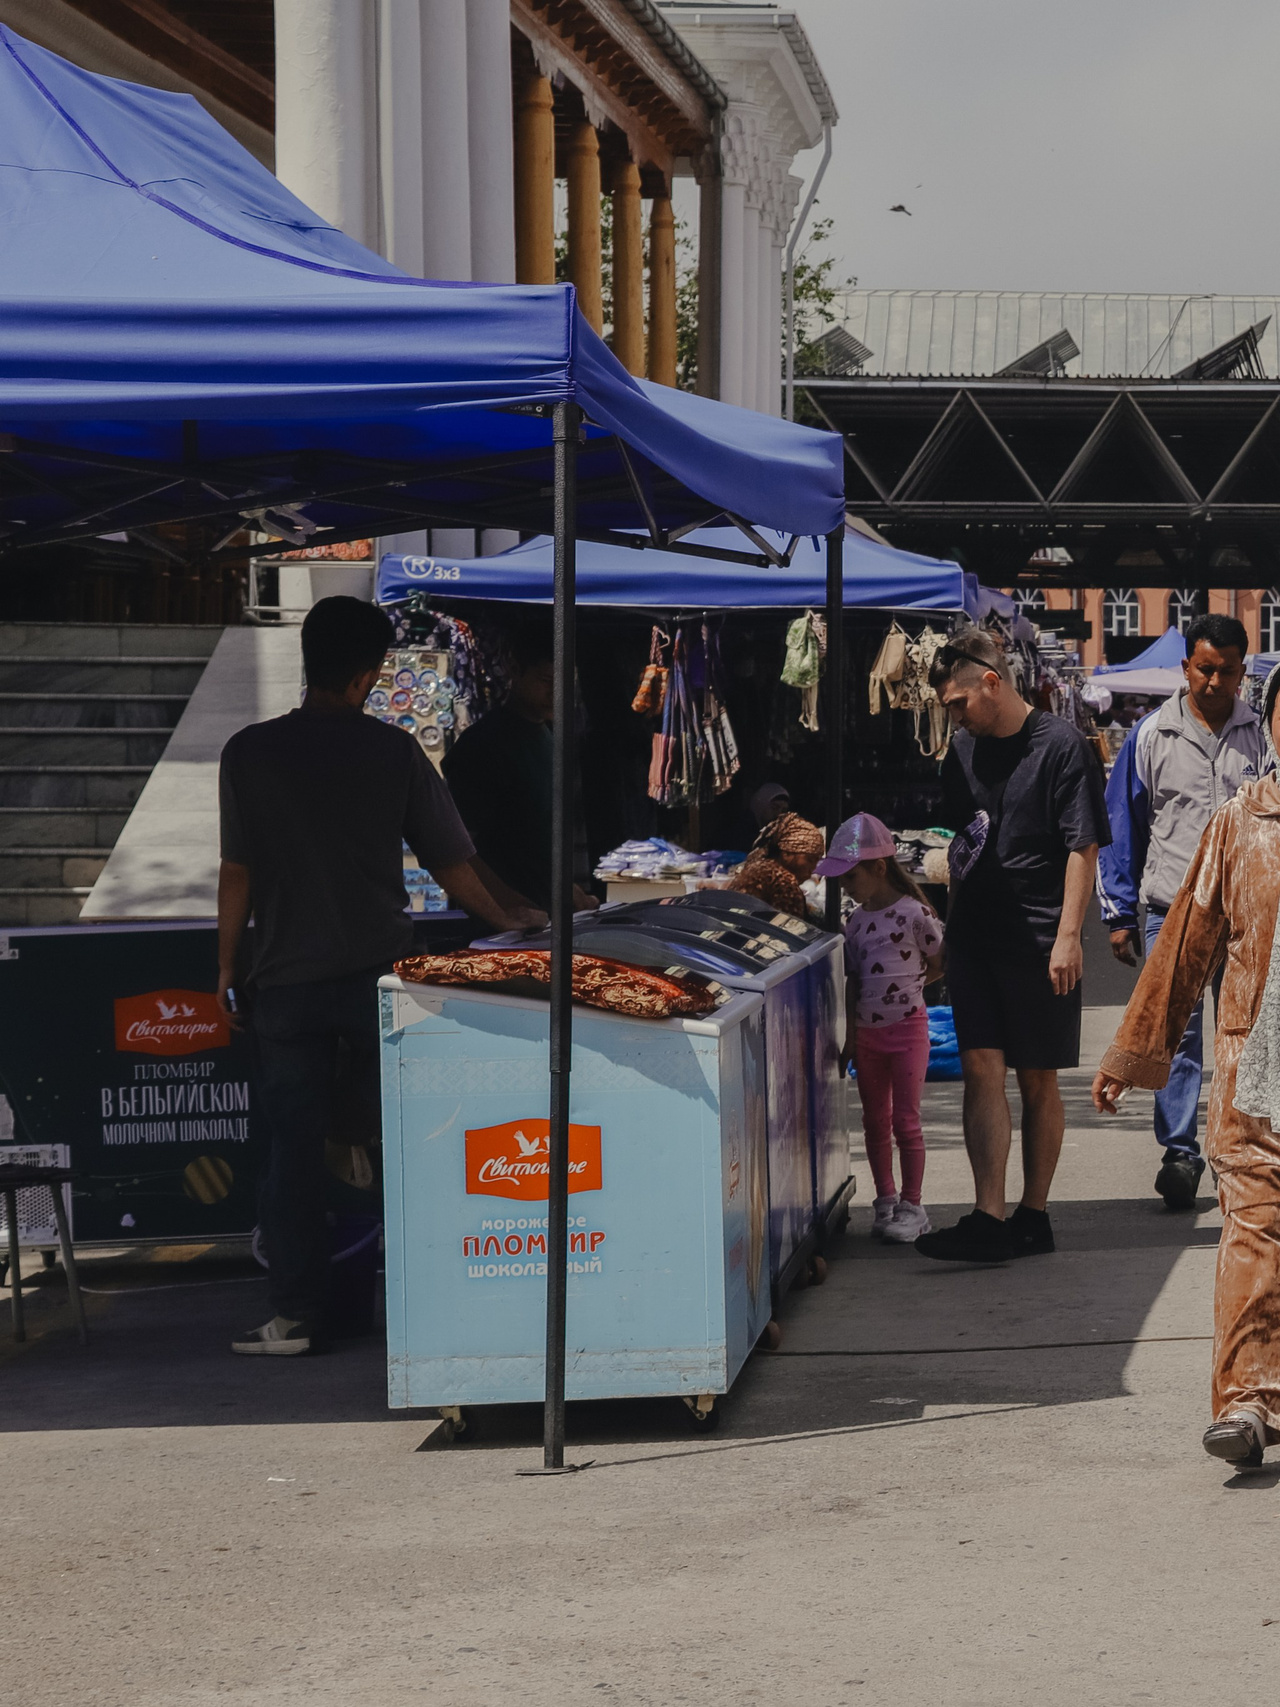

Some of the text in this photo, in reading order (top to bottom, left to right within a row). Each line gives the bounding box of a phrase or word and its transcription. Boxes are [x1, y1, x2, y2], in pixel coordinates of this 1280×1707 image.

[126, 1019, 218, 1044] Свитлогорье
[134, 1061, 215, 1080] ПЛОМБИР
[101, 1080, 249, 1118] В БЕЛЬГИЙСКОМ
[103, 1117, 249, 1145] МОЛОЧНОМ ШОКОЛАДЕ
[478, 1155, 588, 1186] Свитлогье
[482, 1216, 587, 1233] морожеое
[462, 1231, 606, 1258] ПЛОМИР
[468, 1256, 602, 1279] шоколаый
